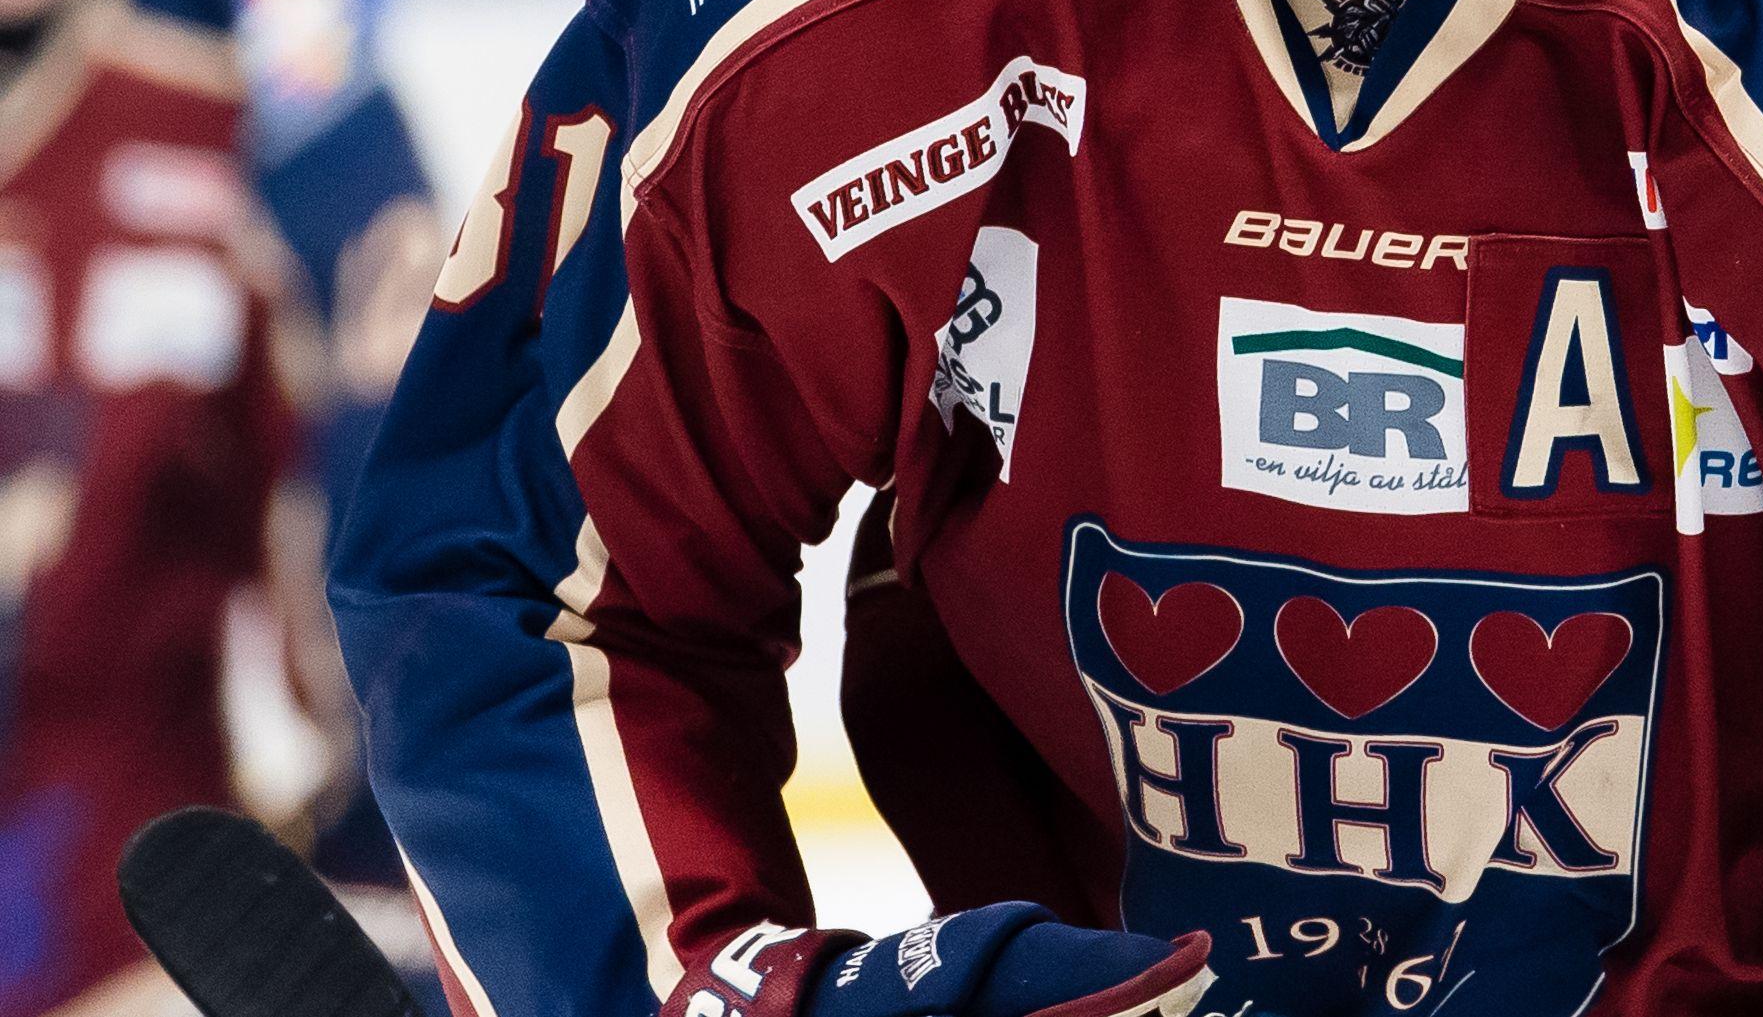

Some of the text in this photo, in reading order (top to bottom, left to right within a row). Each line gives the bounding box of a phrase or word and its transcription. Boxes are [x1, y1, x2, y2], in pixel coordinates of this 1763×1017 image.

[807, 114, 998, 241] VEINGE
[1259, 358, 1447, 461] BR
[1505, 272, 1646, 494] A
[1293, 454, 1361, 496] vilja
[1368, 473, 1405, 491] av
[1411, 461, 1470, 492] stål
